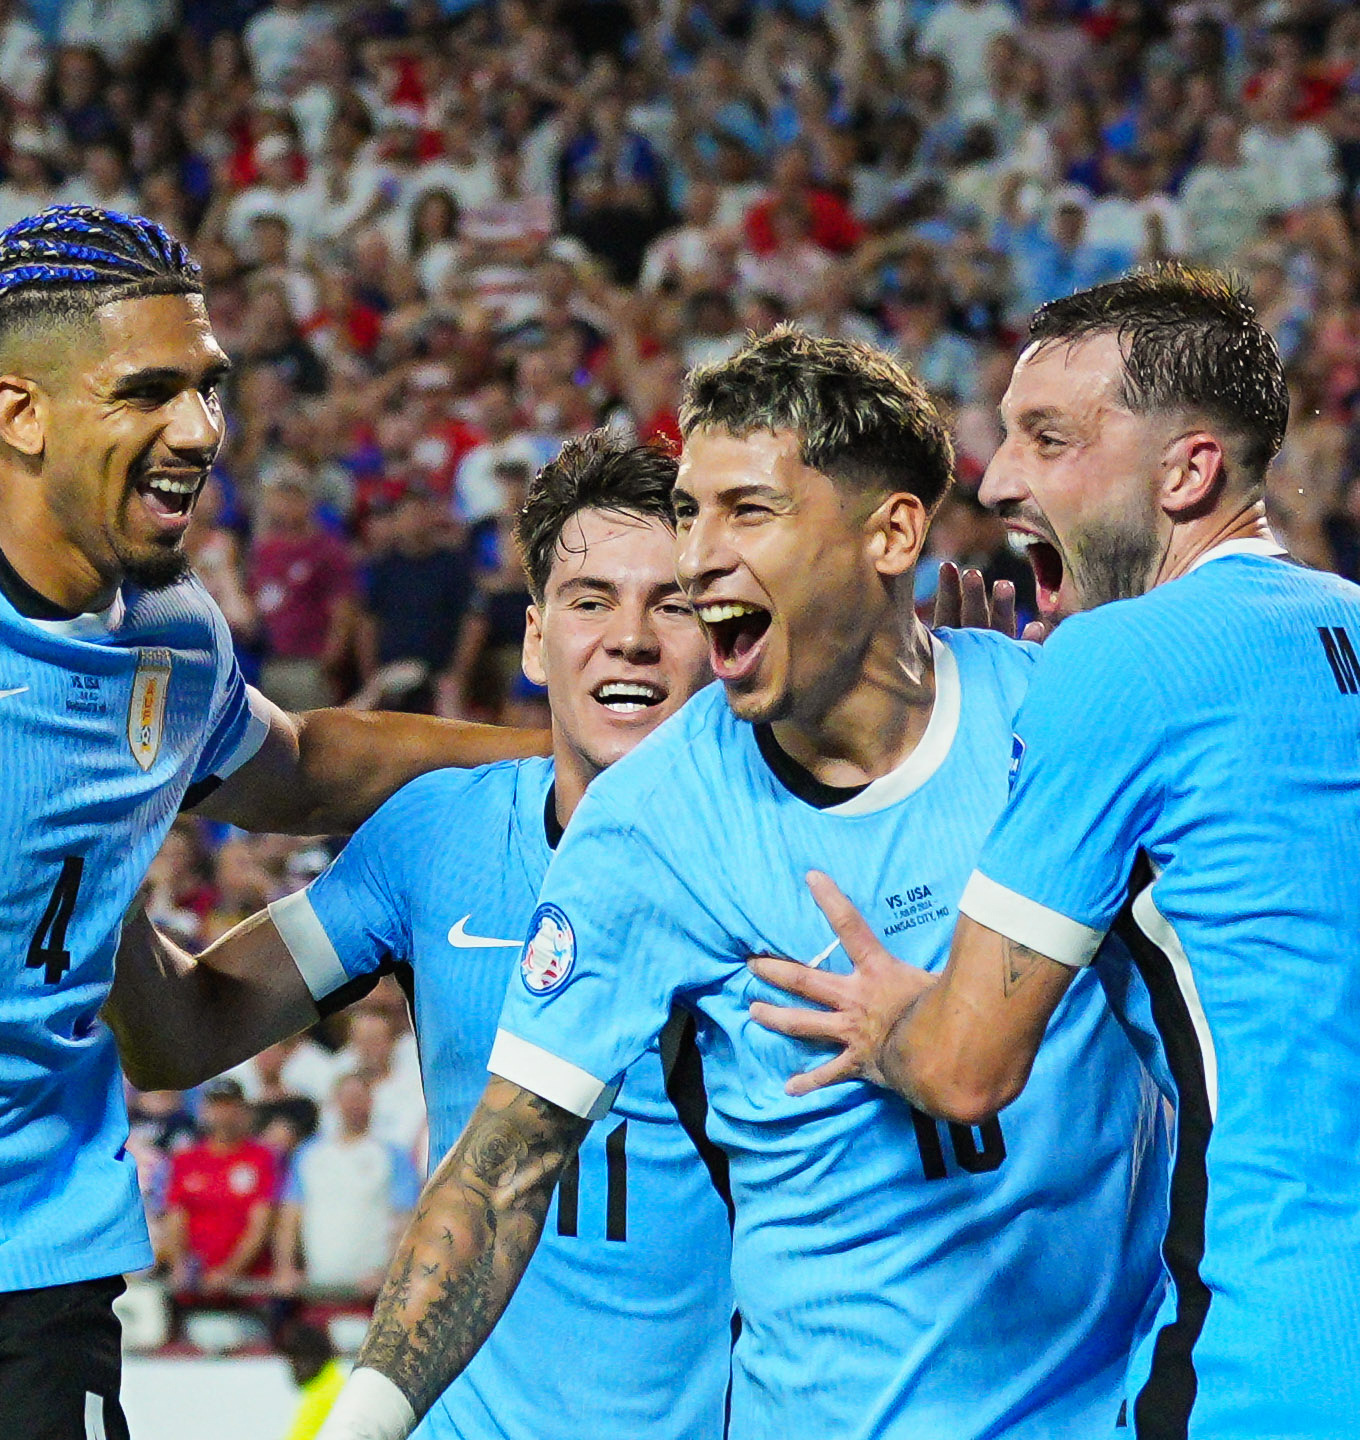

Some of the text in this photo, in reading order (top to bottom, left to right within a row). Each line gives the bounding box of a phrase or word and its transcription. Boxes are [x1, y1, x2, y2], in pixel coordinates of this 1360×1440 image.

[26, 856, 84, 985] 4
[884, 918, 916, 937] KANSAS
[936, 906, 950, 919] MO
[885, 884, 933, 909] VS. USA
[556, 1117, 628, 1242] 11
